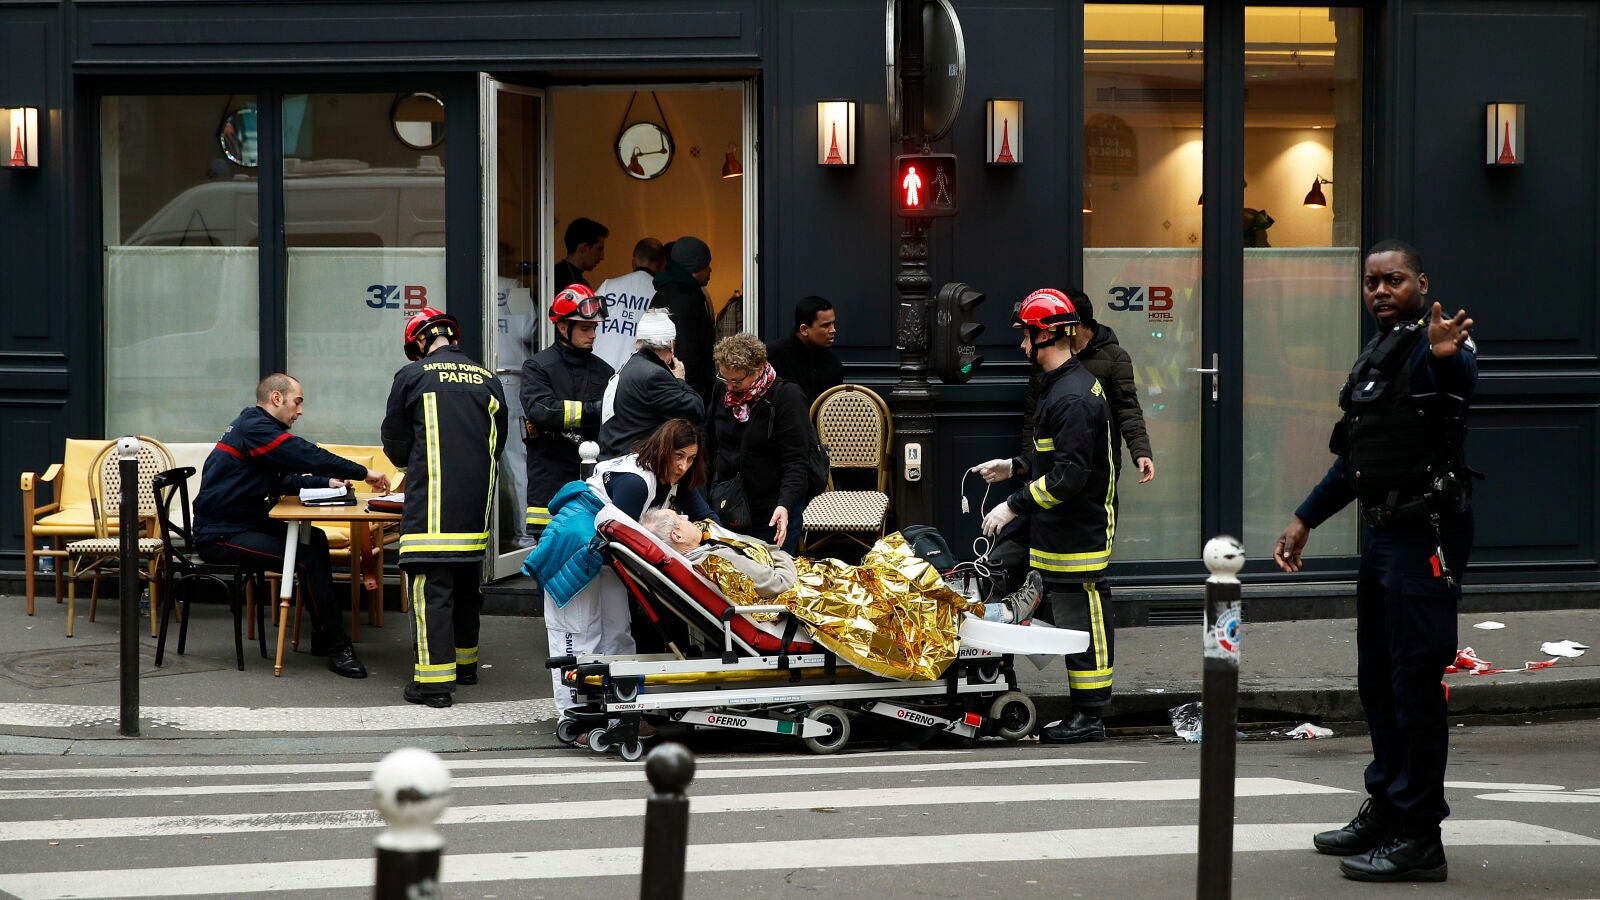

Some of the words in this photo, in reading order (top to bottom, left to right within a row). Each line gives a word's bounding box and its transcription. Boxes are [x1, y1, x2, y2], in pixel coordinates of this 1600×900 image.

[622, 310, 635, 320] DE
[423, 362, 457, 372] SAPEURS
[458, 363, 494, 379] POMPIERS
[439, 371, 484, 385] PARIS
[715, 716, 748, 728] FERNO
[904, 711, 935, 726] FERNO
